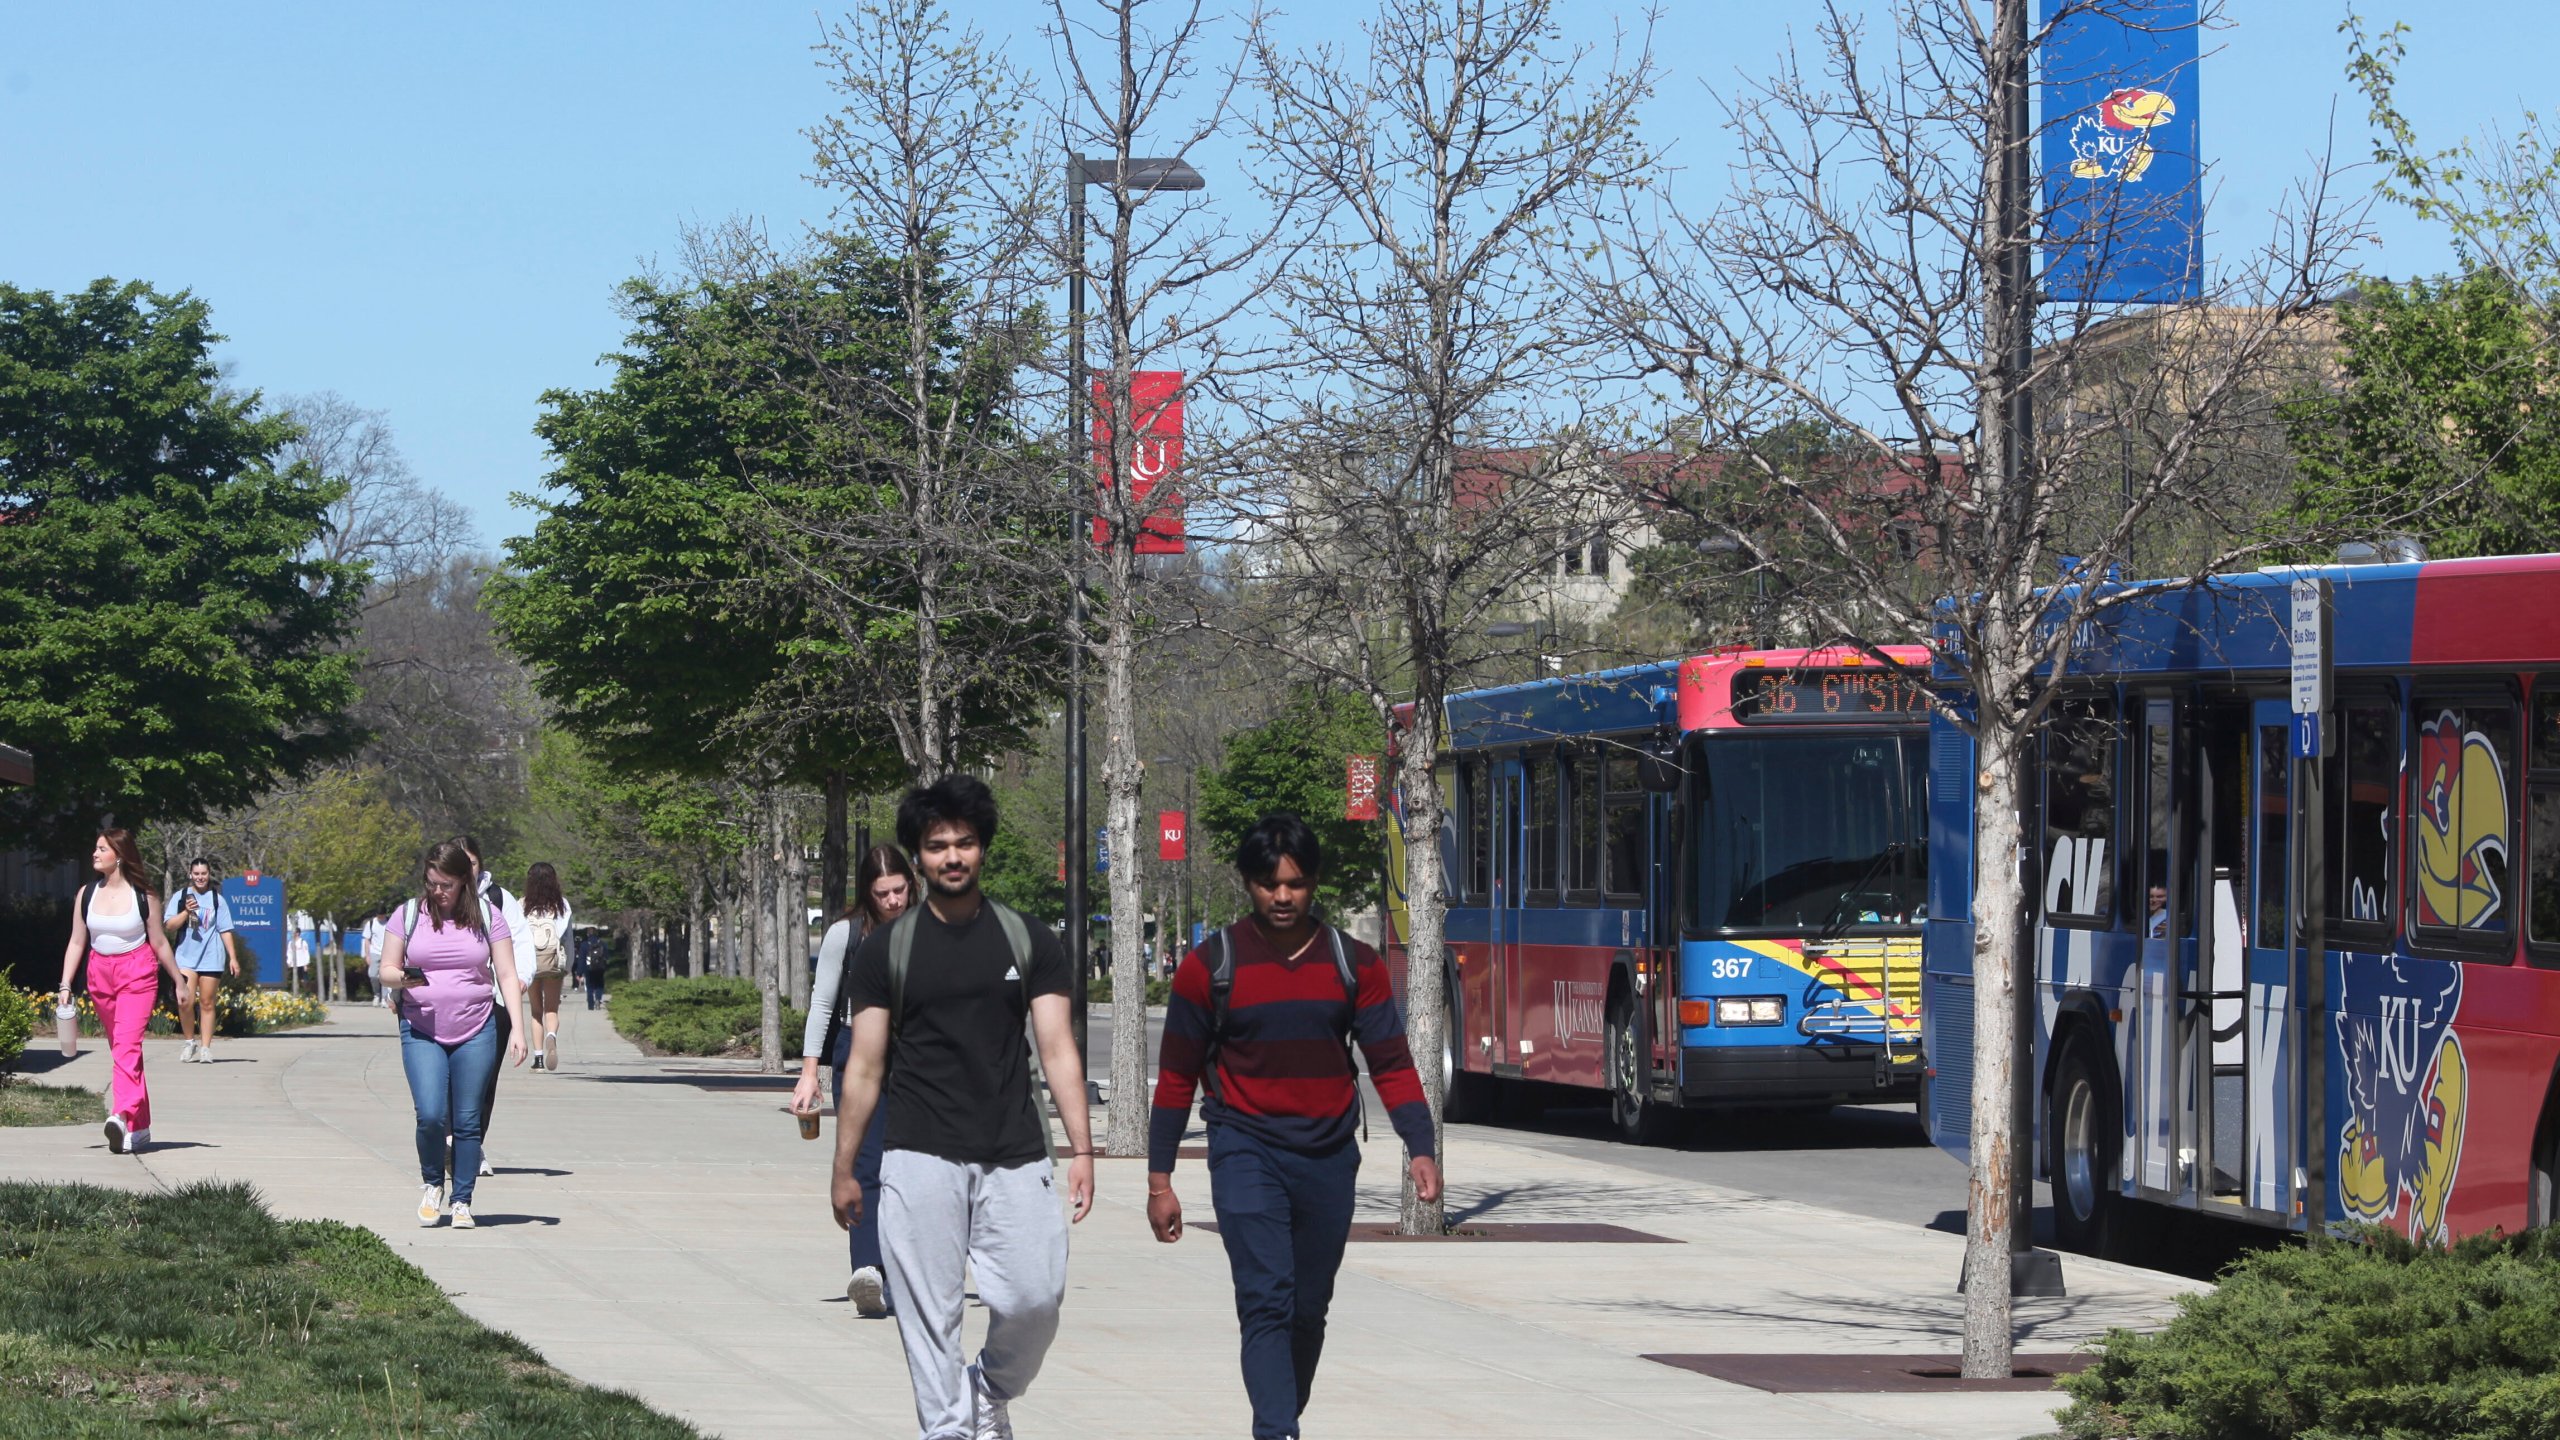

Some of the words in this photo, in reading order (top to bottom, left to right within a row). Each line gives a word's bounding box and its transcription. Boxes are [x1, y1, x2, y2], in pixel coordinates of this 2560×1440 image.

[2097, 136, 2124, 155] KU
[1130, 439, 1168, 481] U
[2296, 608, 2313, 623] Center
[2294, 630, 2304, 644] Bus
[2304, 629, 2316, 645] Stop
[1759, 674, 1797, 714] 36
[2301, 719, 2311, 751] D
[1351, 759, 1364, 808] CHALK
[1164, 829, 1181, 842] KU
[231, 895, 274, 905] WESCOE
[240, 906, 267, 916] HALL
[1712, 958, 1753, 979] 367
[1553, 980, 1573, 1049] KU
[1572, 998, 1604, 1035] KANSAS
[2379, 995, 2422, 1095] KU
